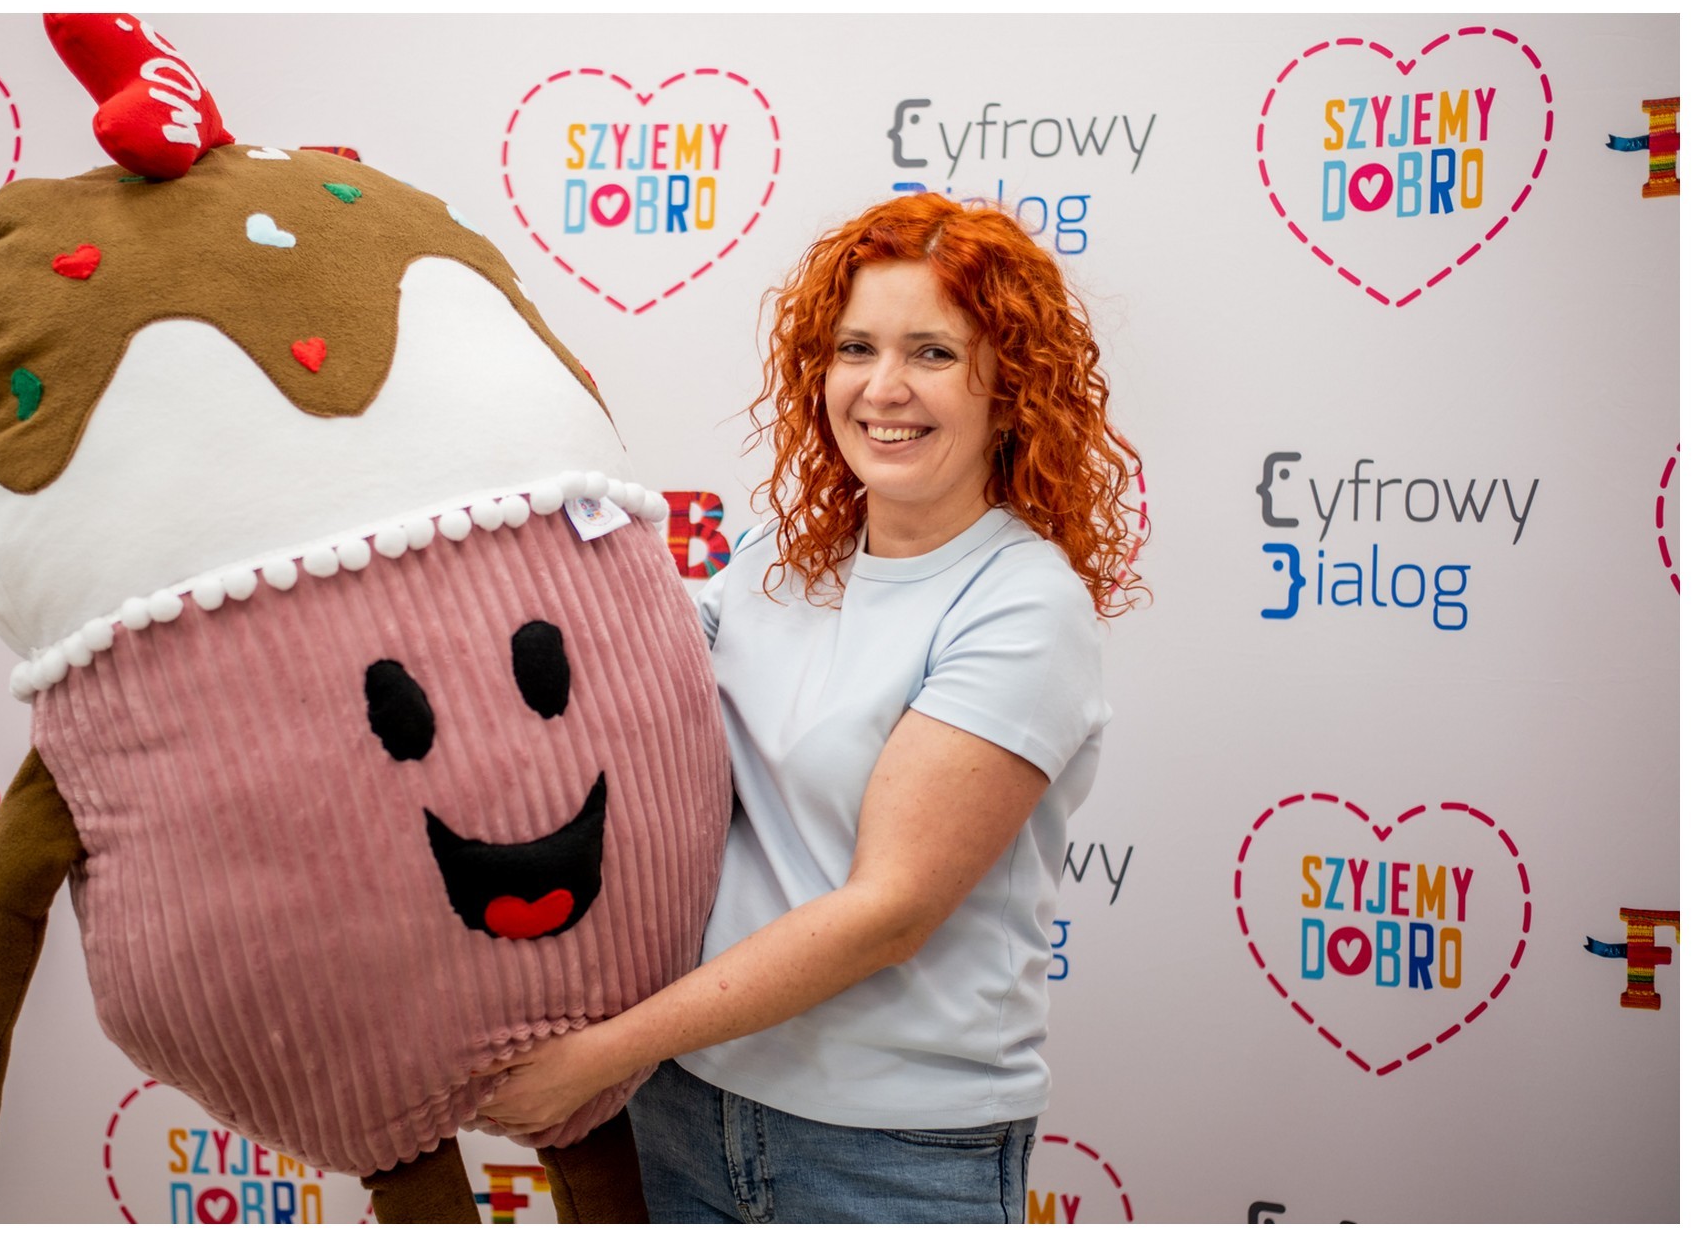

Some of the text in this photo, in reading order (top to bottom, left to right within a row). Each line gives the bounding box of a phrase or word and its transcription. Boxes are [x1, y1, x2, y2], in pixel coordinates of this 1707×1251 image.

[565, 123, 728, 171] SZYJEMY
[887, 99, 1156, 179] Cyfrowy
[1323, 87, 1496, 151] SZYJEMY
[564, 174, 717, 234] DOBRO
[892, 180, 1093, 255] log
[1322, 147, 1484, 222] DOBRO
[1256, 452, 1539, 545] Cyfrowy
[1260, 542, 1471, 631] Dialog
[1301, 855, 1474, 922] SZYJEMY
[1301, 918, 1462, 991] DOBRO
[168, 1128, 323, 1177] SZYJE
